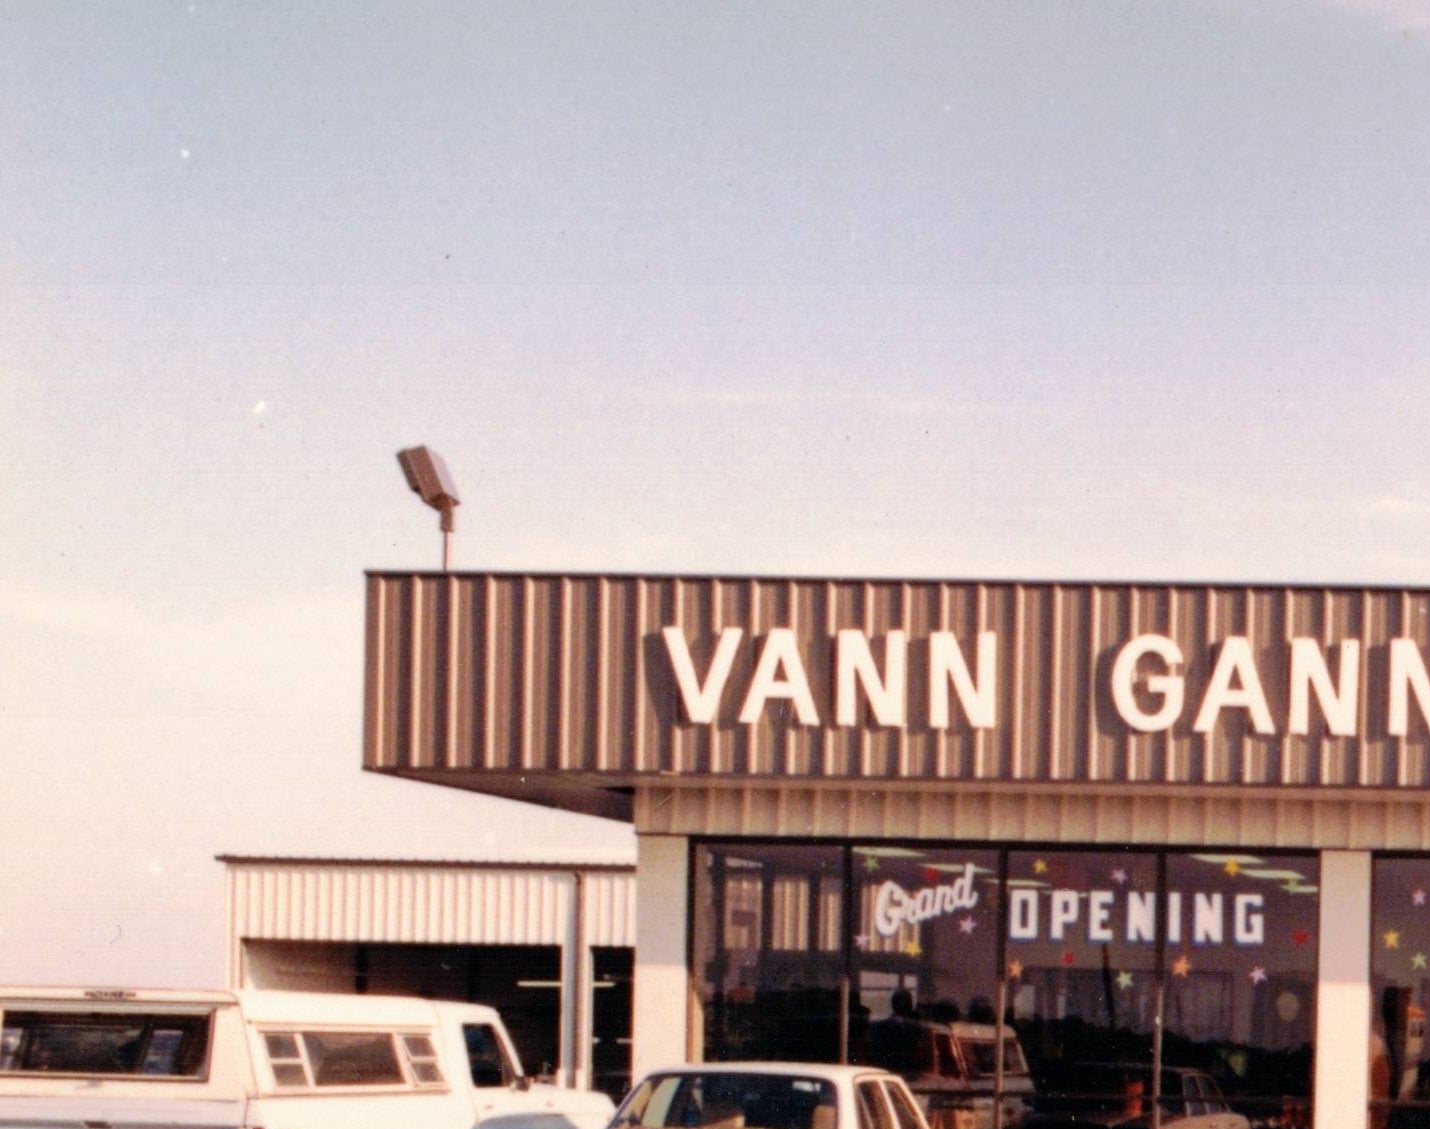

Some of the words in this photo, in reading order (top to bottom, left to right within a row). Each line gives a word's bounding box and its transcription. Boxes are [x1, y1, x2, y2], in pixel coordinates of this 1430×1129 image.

[663, 626, 996, 729] VANN
[875, 863, 978, 938] Grand
[1009, 888, 1264, 945] OPENING
